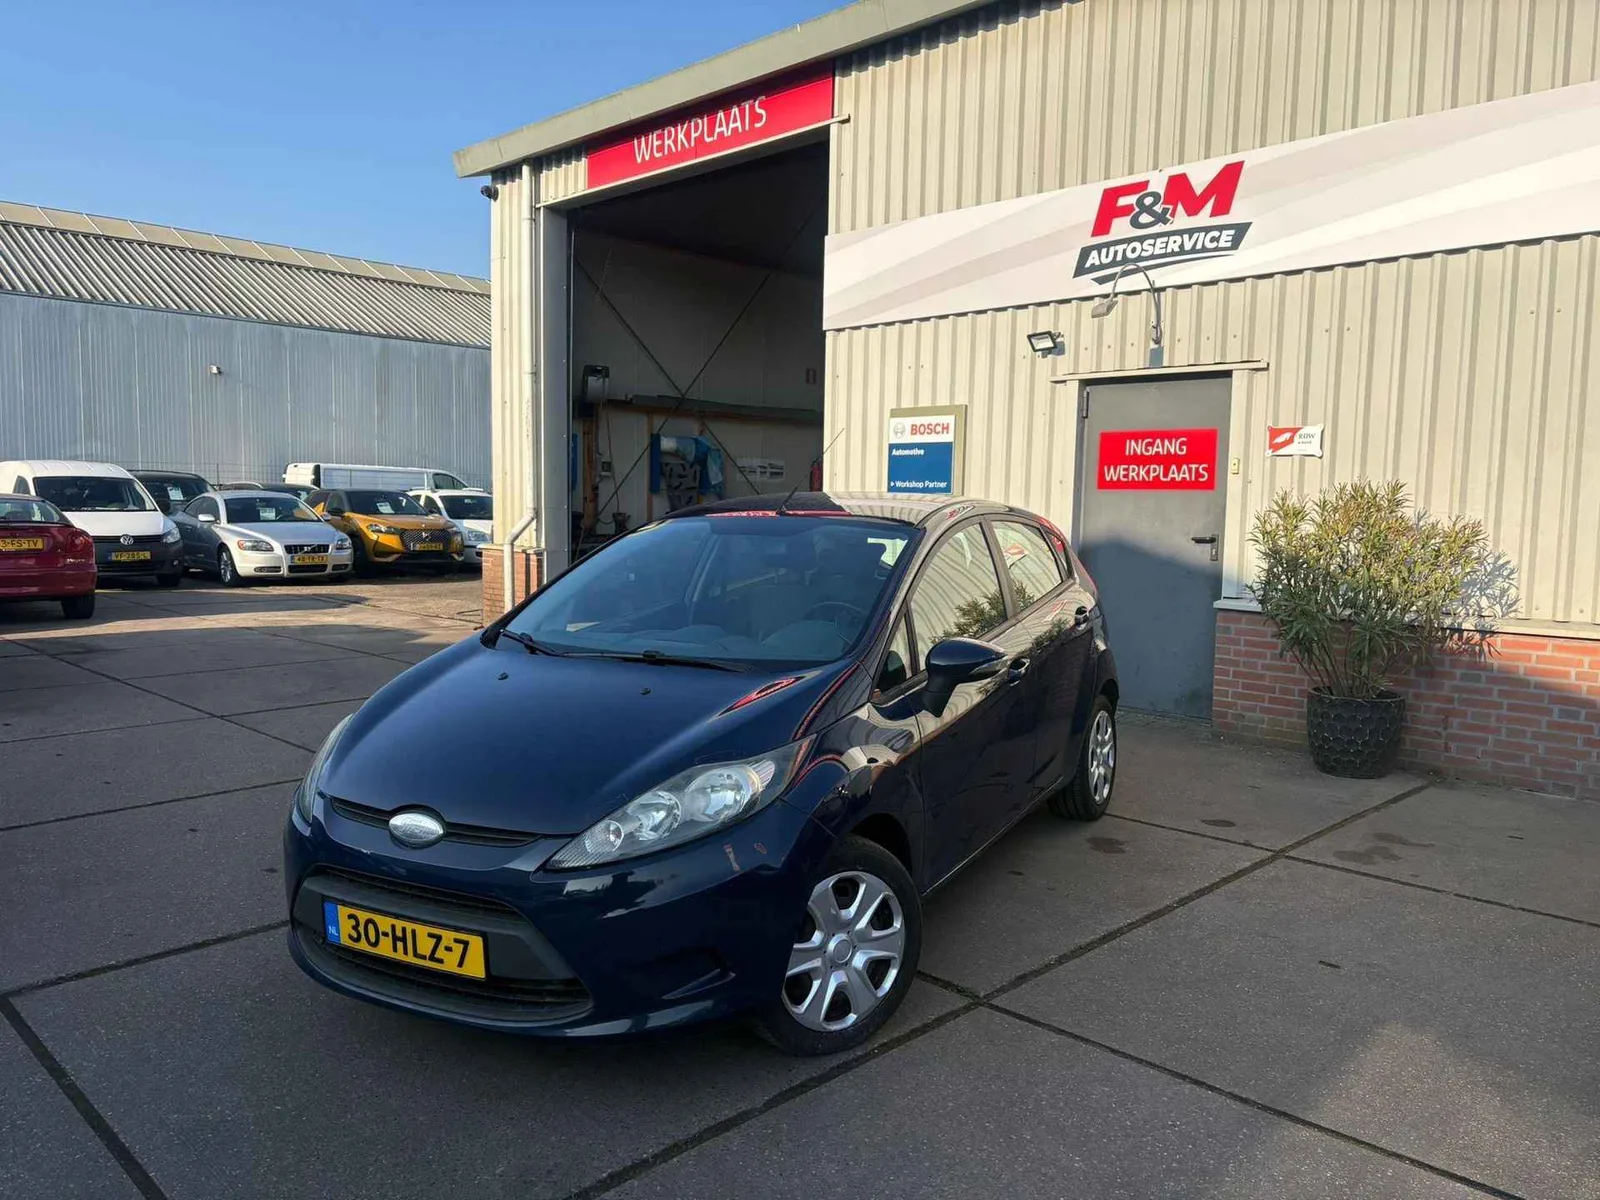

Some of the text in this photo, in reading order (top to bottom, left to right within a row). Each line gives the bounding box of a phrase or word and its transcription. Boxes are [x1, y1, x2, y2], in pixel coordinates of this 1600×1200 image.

[633, 95, 768, 164] WERKPLAATS
[1090, 160, 1246, 238] F&M
[1084, 229, 1236, 269] AUTOSERVICE
[910, 422, 950, 436] BOSCH
[891, 447, 925, 456] Automotive
[1125, 437, 1188, 456] INGANG
[1103, 463, 1209, 482] WERKPLAATS
[895, 480, 948, 489] Workshop Partner
[327, 924, 339, 937] NL
[346, 913, 470, 969] 30-HLZ-7
